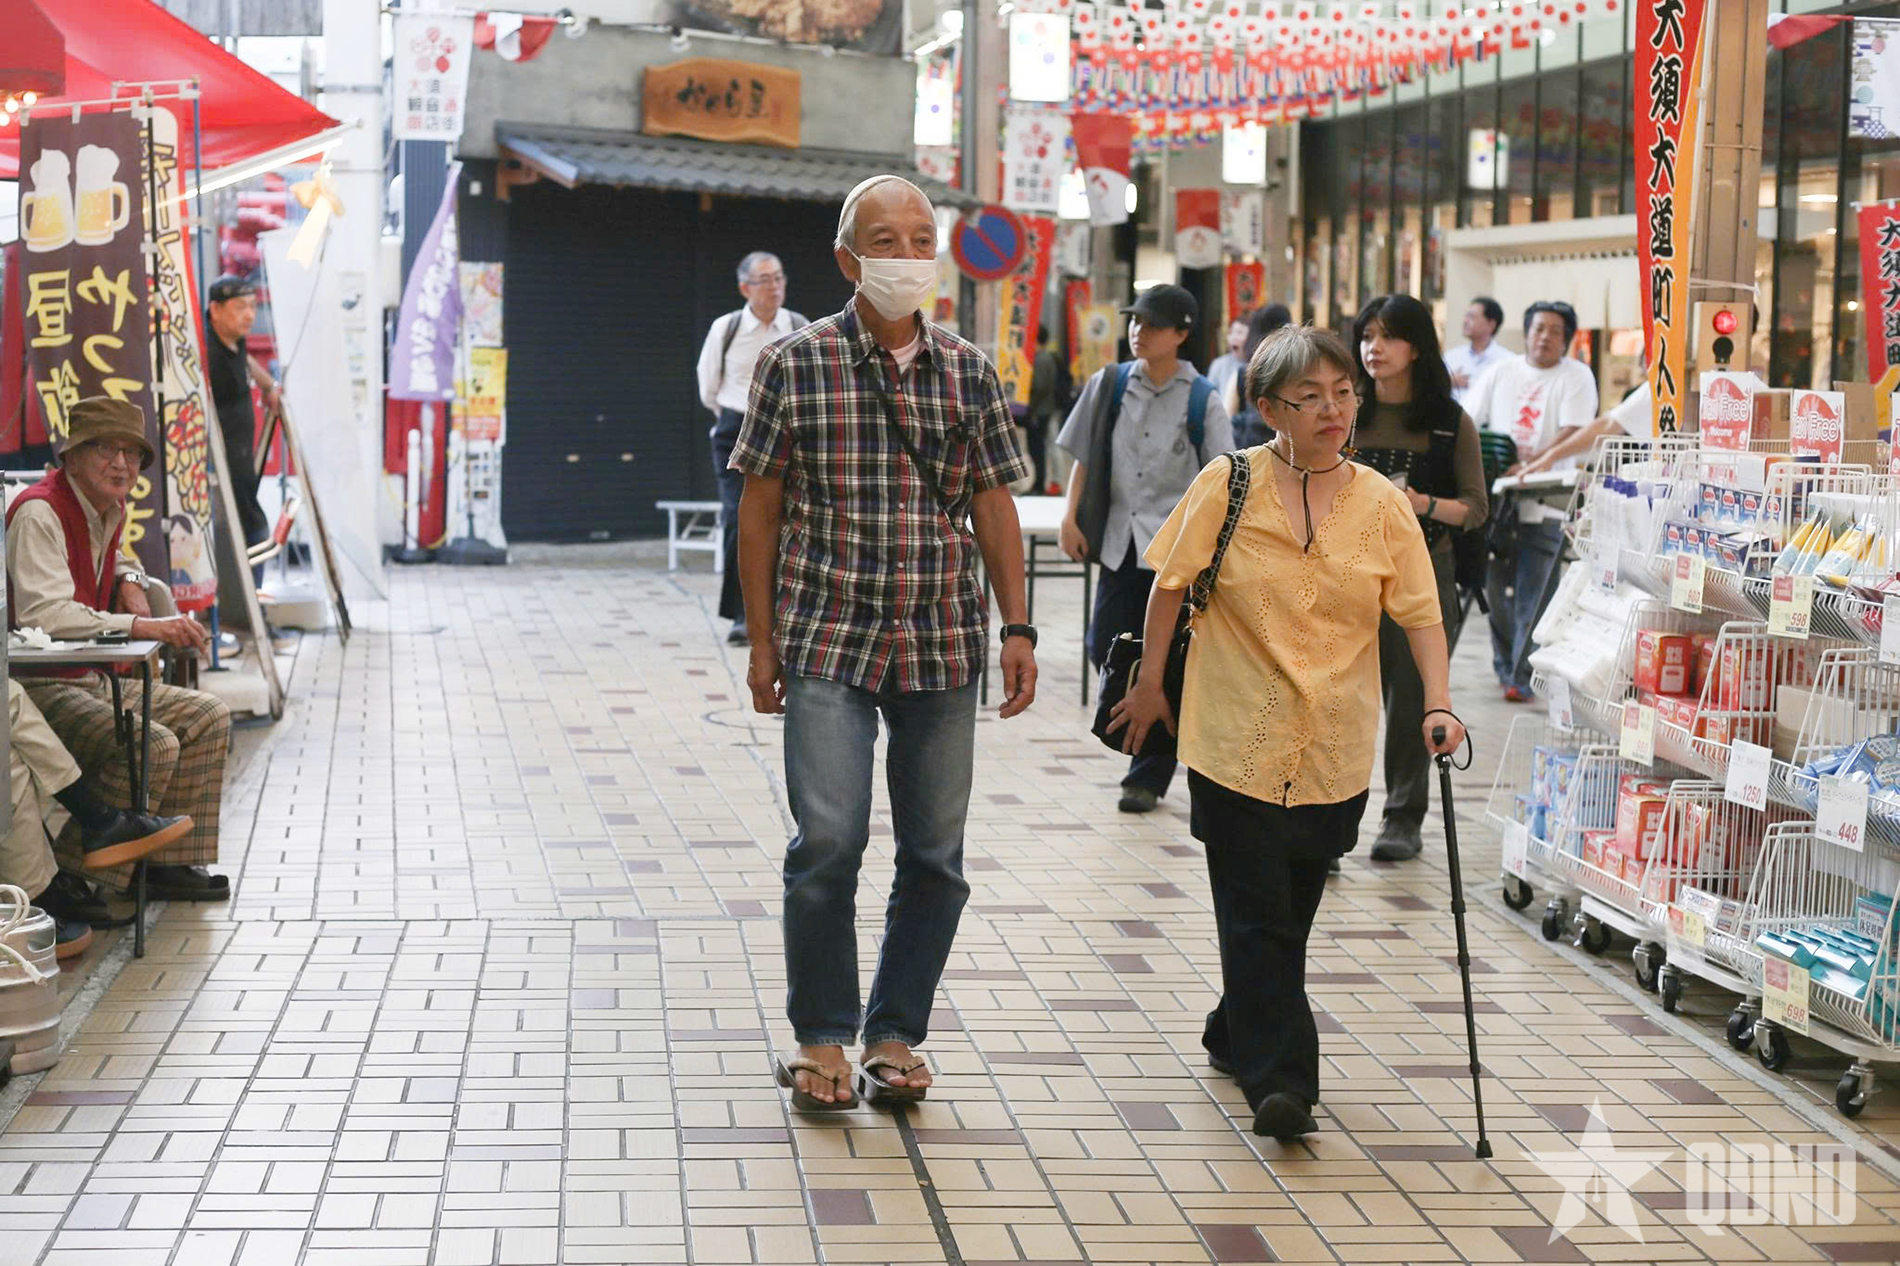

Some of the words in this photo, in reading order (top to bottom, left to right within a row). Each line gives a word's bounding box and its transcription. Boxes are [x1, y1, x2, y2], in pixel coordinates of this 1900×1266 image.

[1719, 392, 1749, 422] Free
[1808, 410, 1839, 442] Free
[1790, 612, 1807, 627] 598
[1743, 784, 1761, 804] 1250
[1838, 822, 1858, 844] 448
[1787, 1003, 1805, 1023] 698
